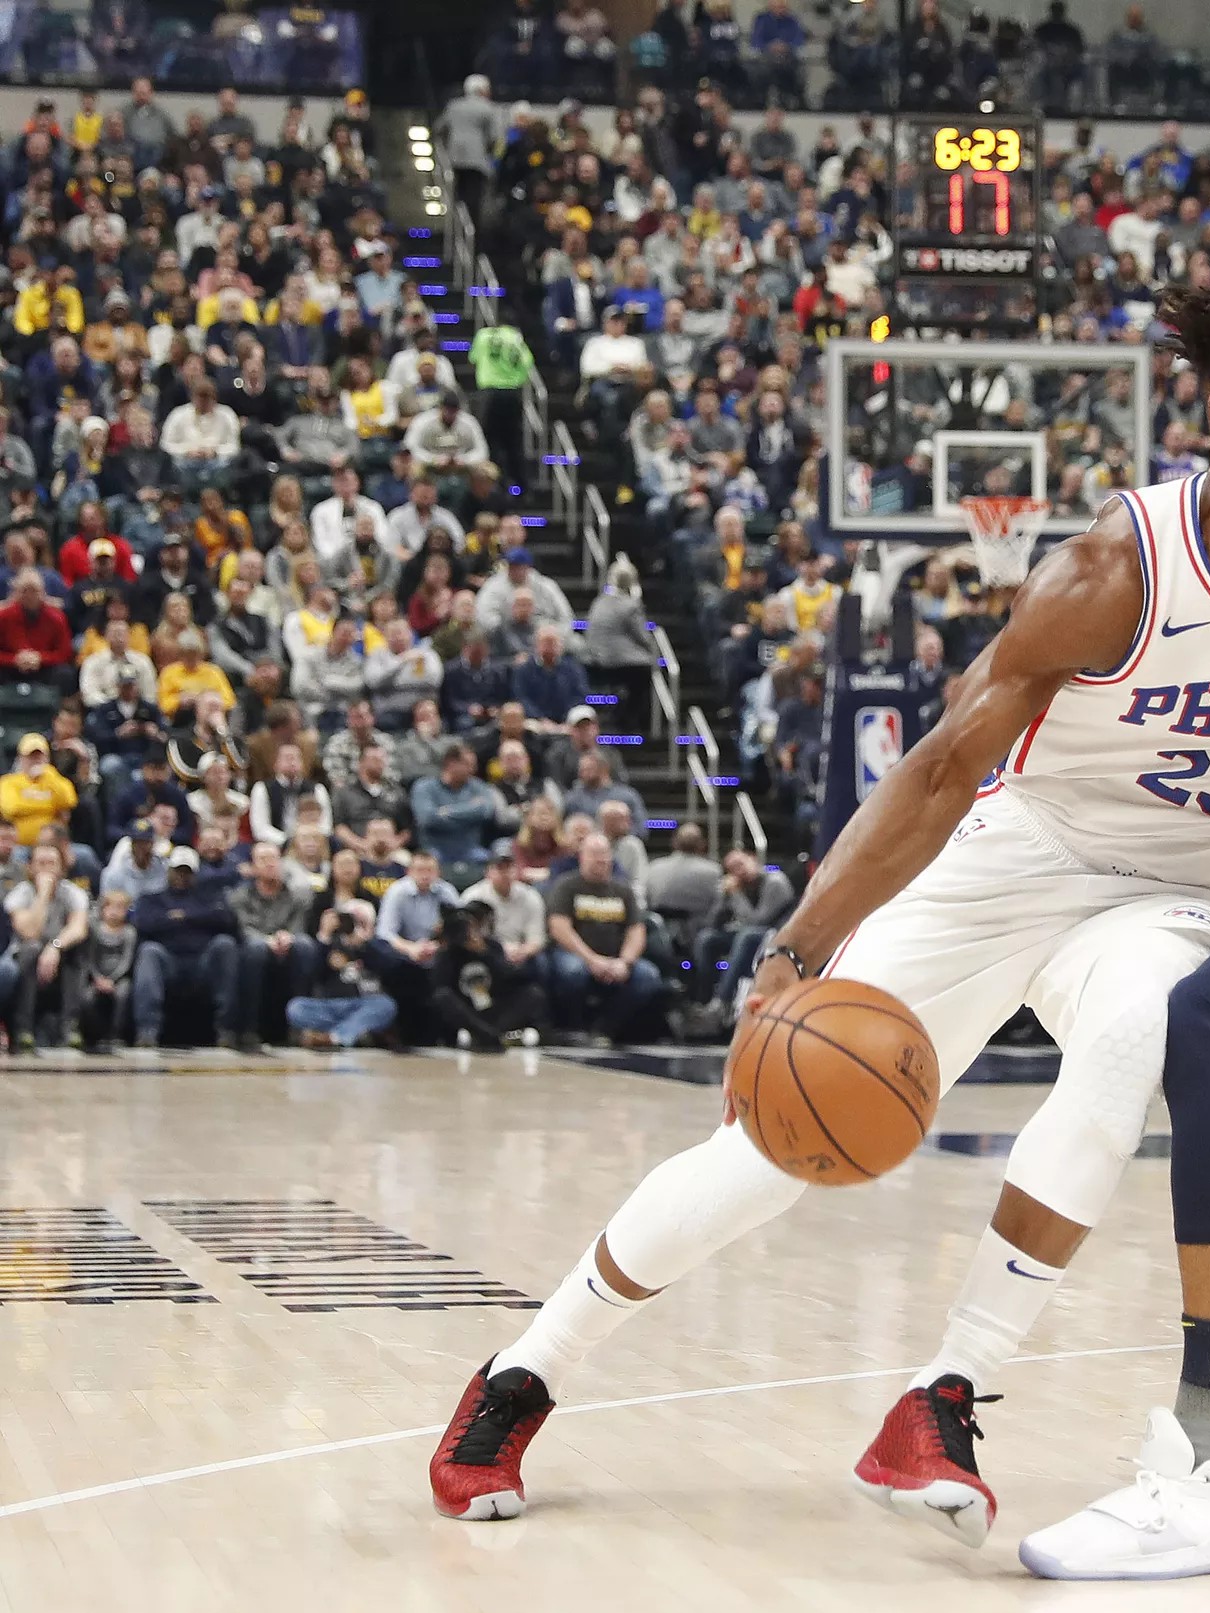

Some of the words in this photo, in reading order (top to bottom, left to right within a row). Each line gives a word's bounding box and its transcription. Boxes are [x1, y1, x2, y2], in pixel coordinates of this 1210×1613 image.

[934, 127, 1021, 172] 6:23
[949, 170, 1010, 235] 17
[941, 249, 1032, 273] TISSOT
